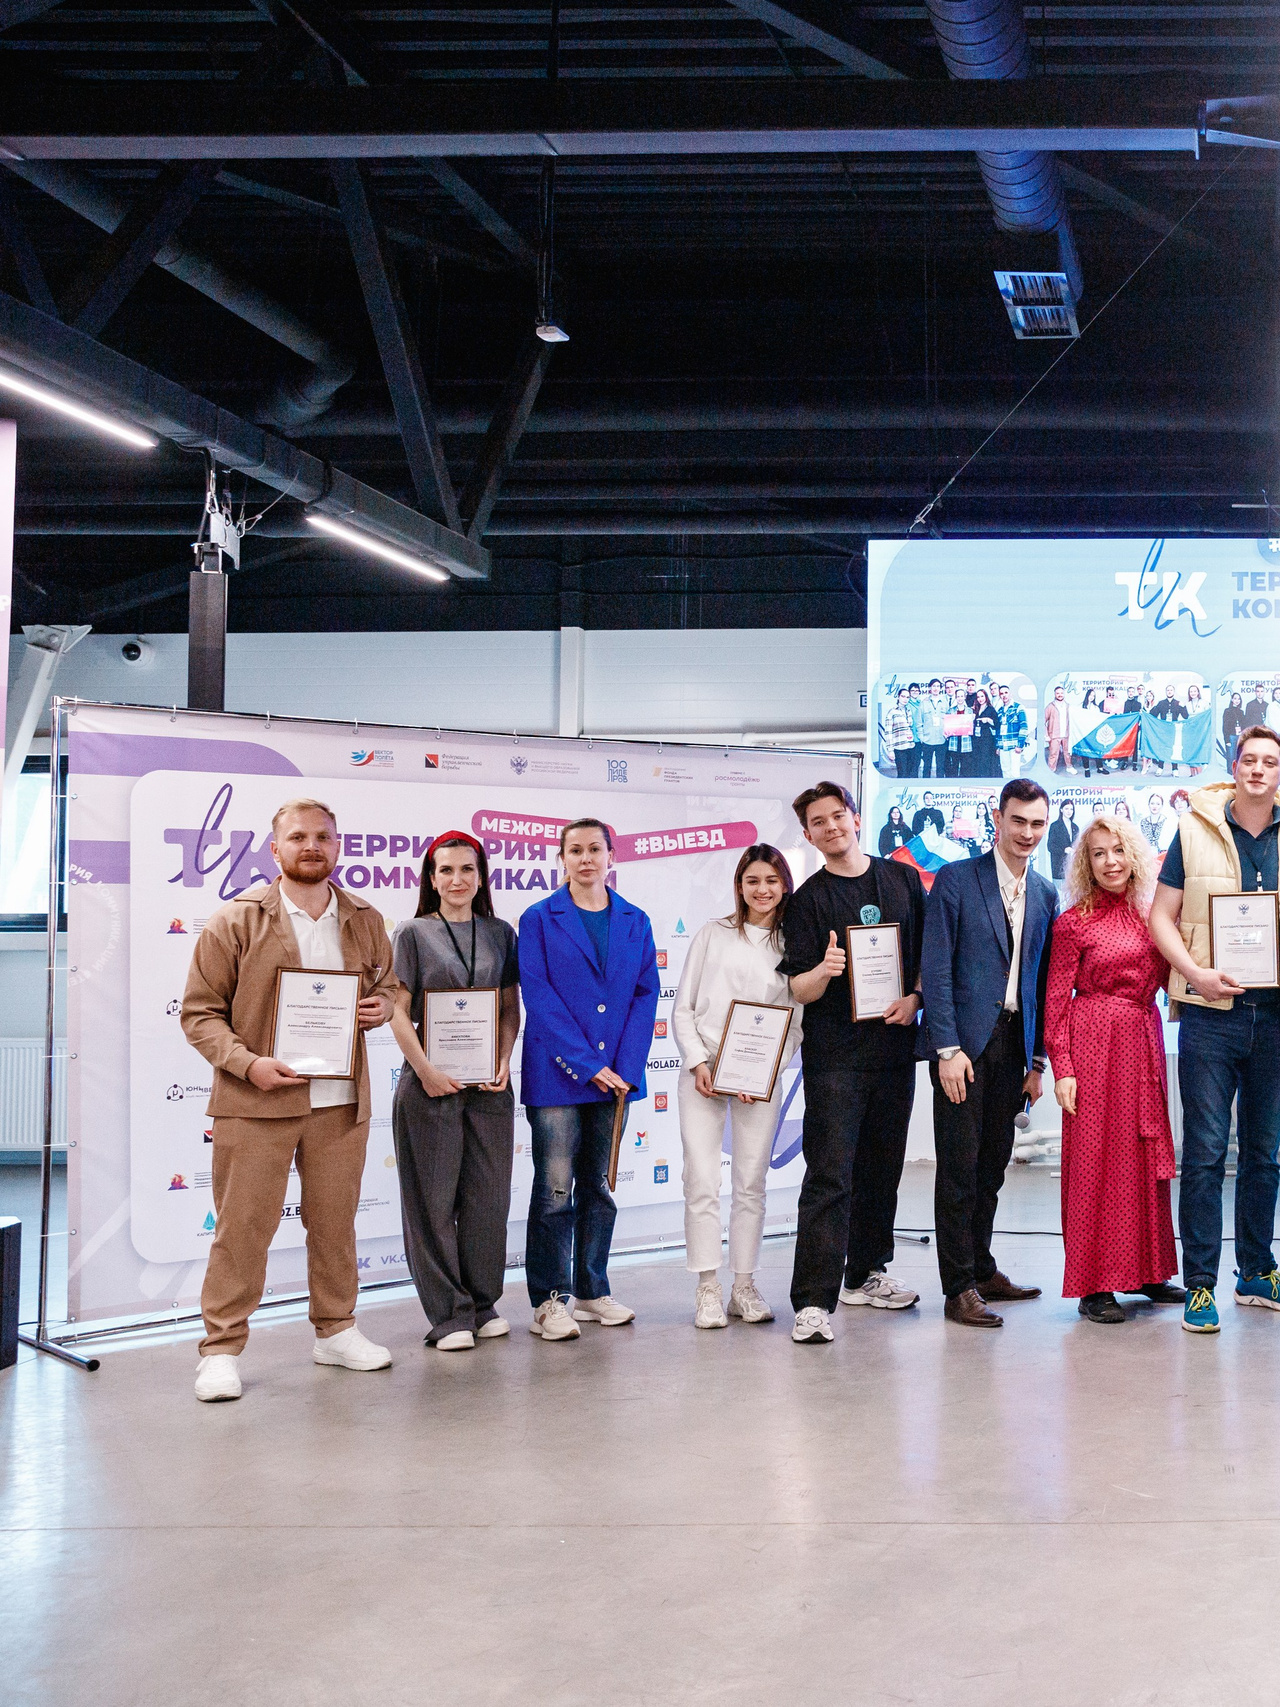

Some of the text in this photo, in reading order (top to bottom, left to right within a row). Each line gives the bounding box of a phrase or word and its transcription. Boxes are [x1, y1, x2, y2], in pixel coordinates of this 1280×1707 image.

[607, 759, 628, 769] 100
[480, 816, 565, 840] МЕЖРЕГ
[634, 828, 727, 855] #ВЫЕЗД
